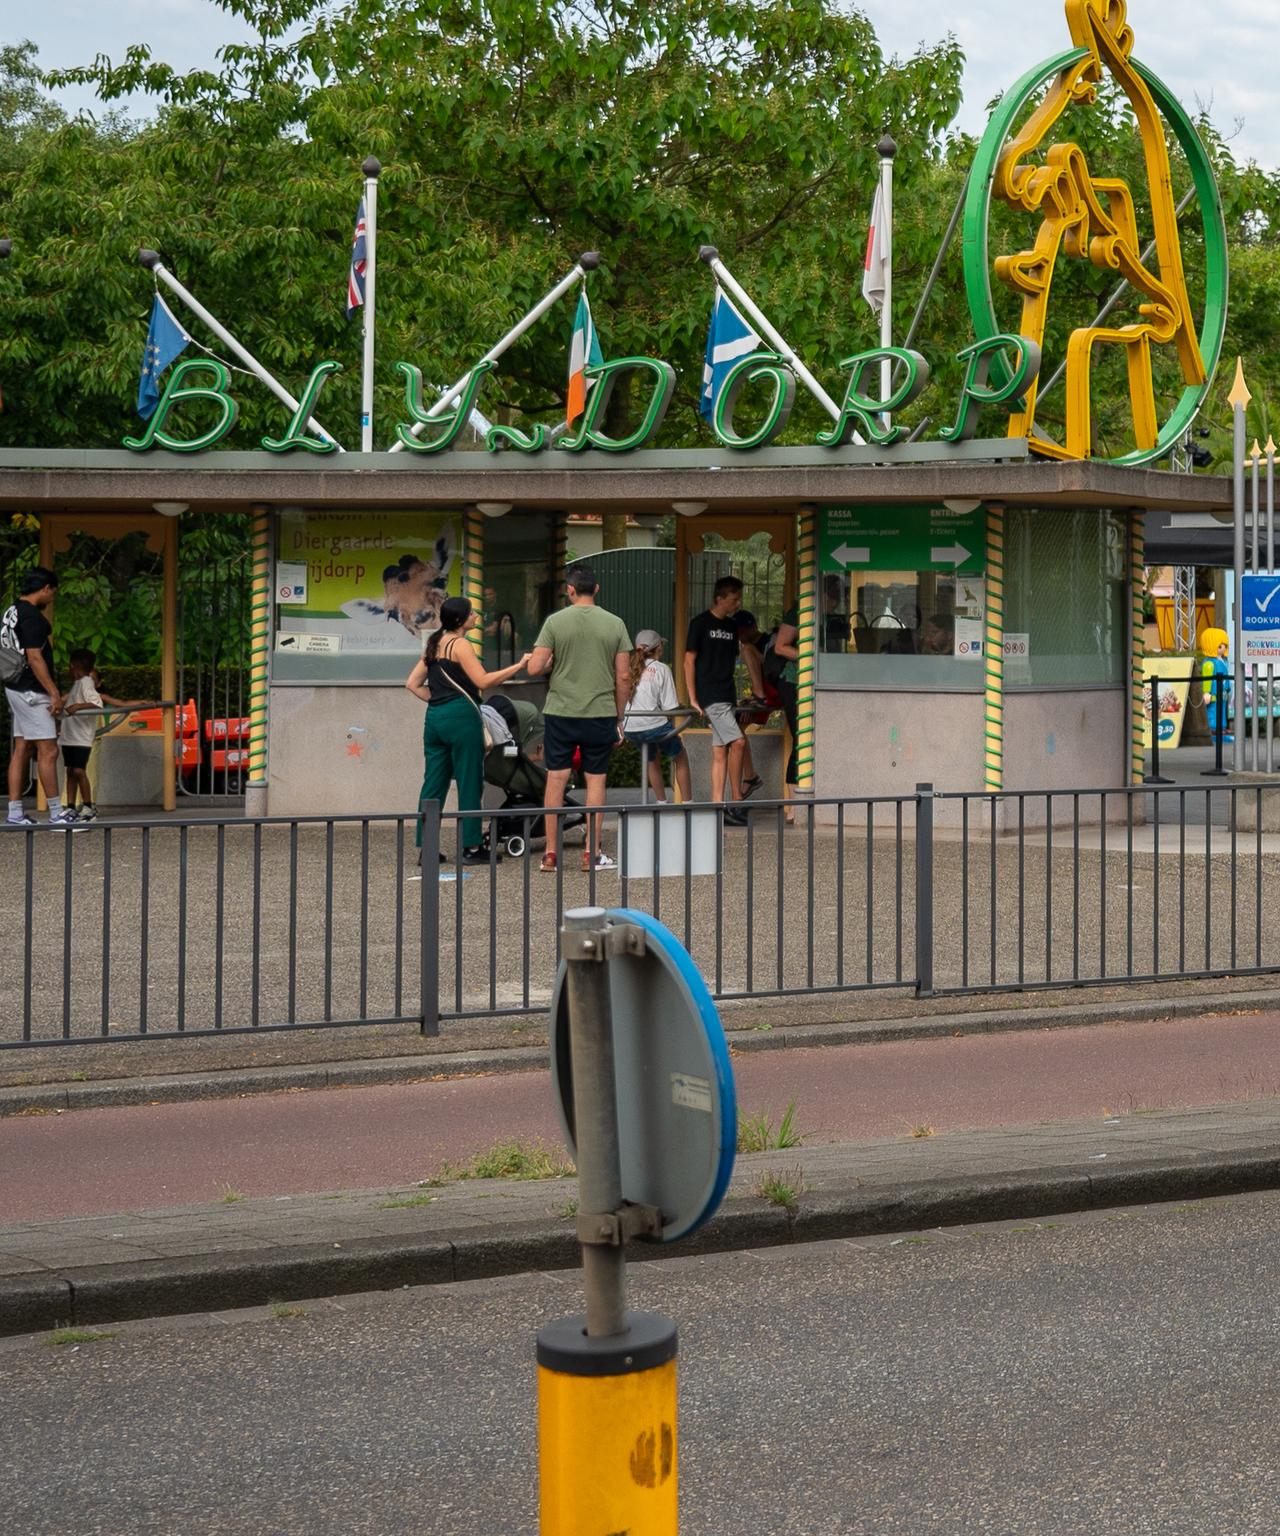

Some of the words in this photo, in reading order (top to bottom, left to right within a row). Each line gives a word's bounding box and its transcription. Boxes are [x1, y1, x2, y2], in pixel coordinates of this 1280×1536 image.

[827, 509, 852, 518] KASSA
[930, 508, 960, 518] ENTRE
[293, 529, 393, 556] Diergaarde
[309, 559, 365, 584] ijdorp
[709, 629, 734, 640] adidas
